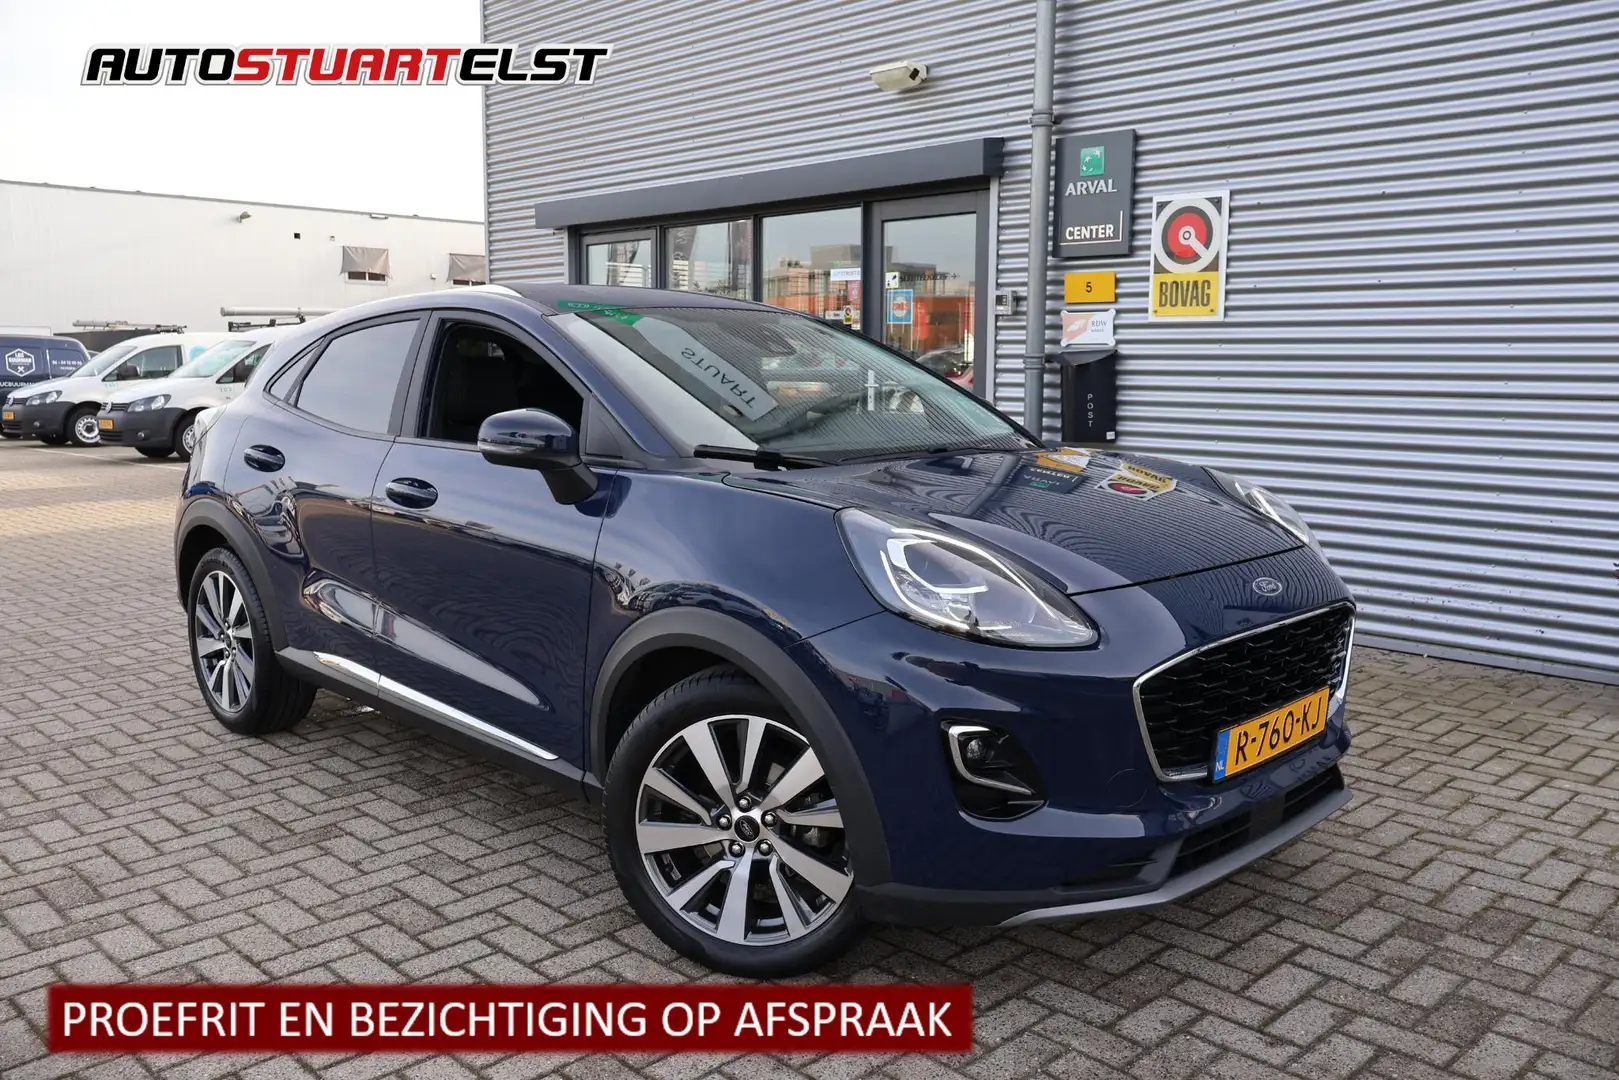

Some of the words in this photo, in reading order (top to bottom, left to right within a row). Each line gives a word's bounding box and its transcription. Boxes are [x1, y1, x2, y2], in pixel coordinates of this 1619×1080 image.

[1065, 179, 1118, 197] ARVAL
[1065, 224, 1114, 240] CENTER
[1085, 281, 1093, 293] 5
[1158, 279, 1211, 307] BOVAG
[1234, 697, 1322, 766] R-760-KJ
[1215, 761, 1224, 772] NL
